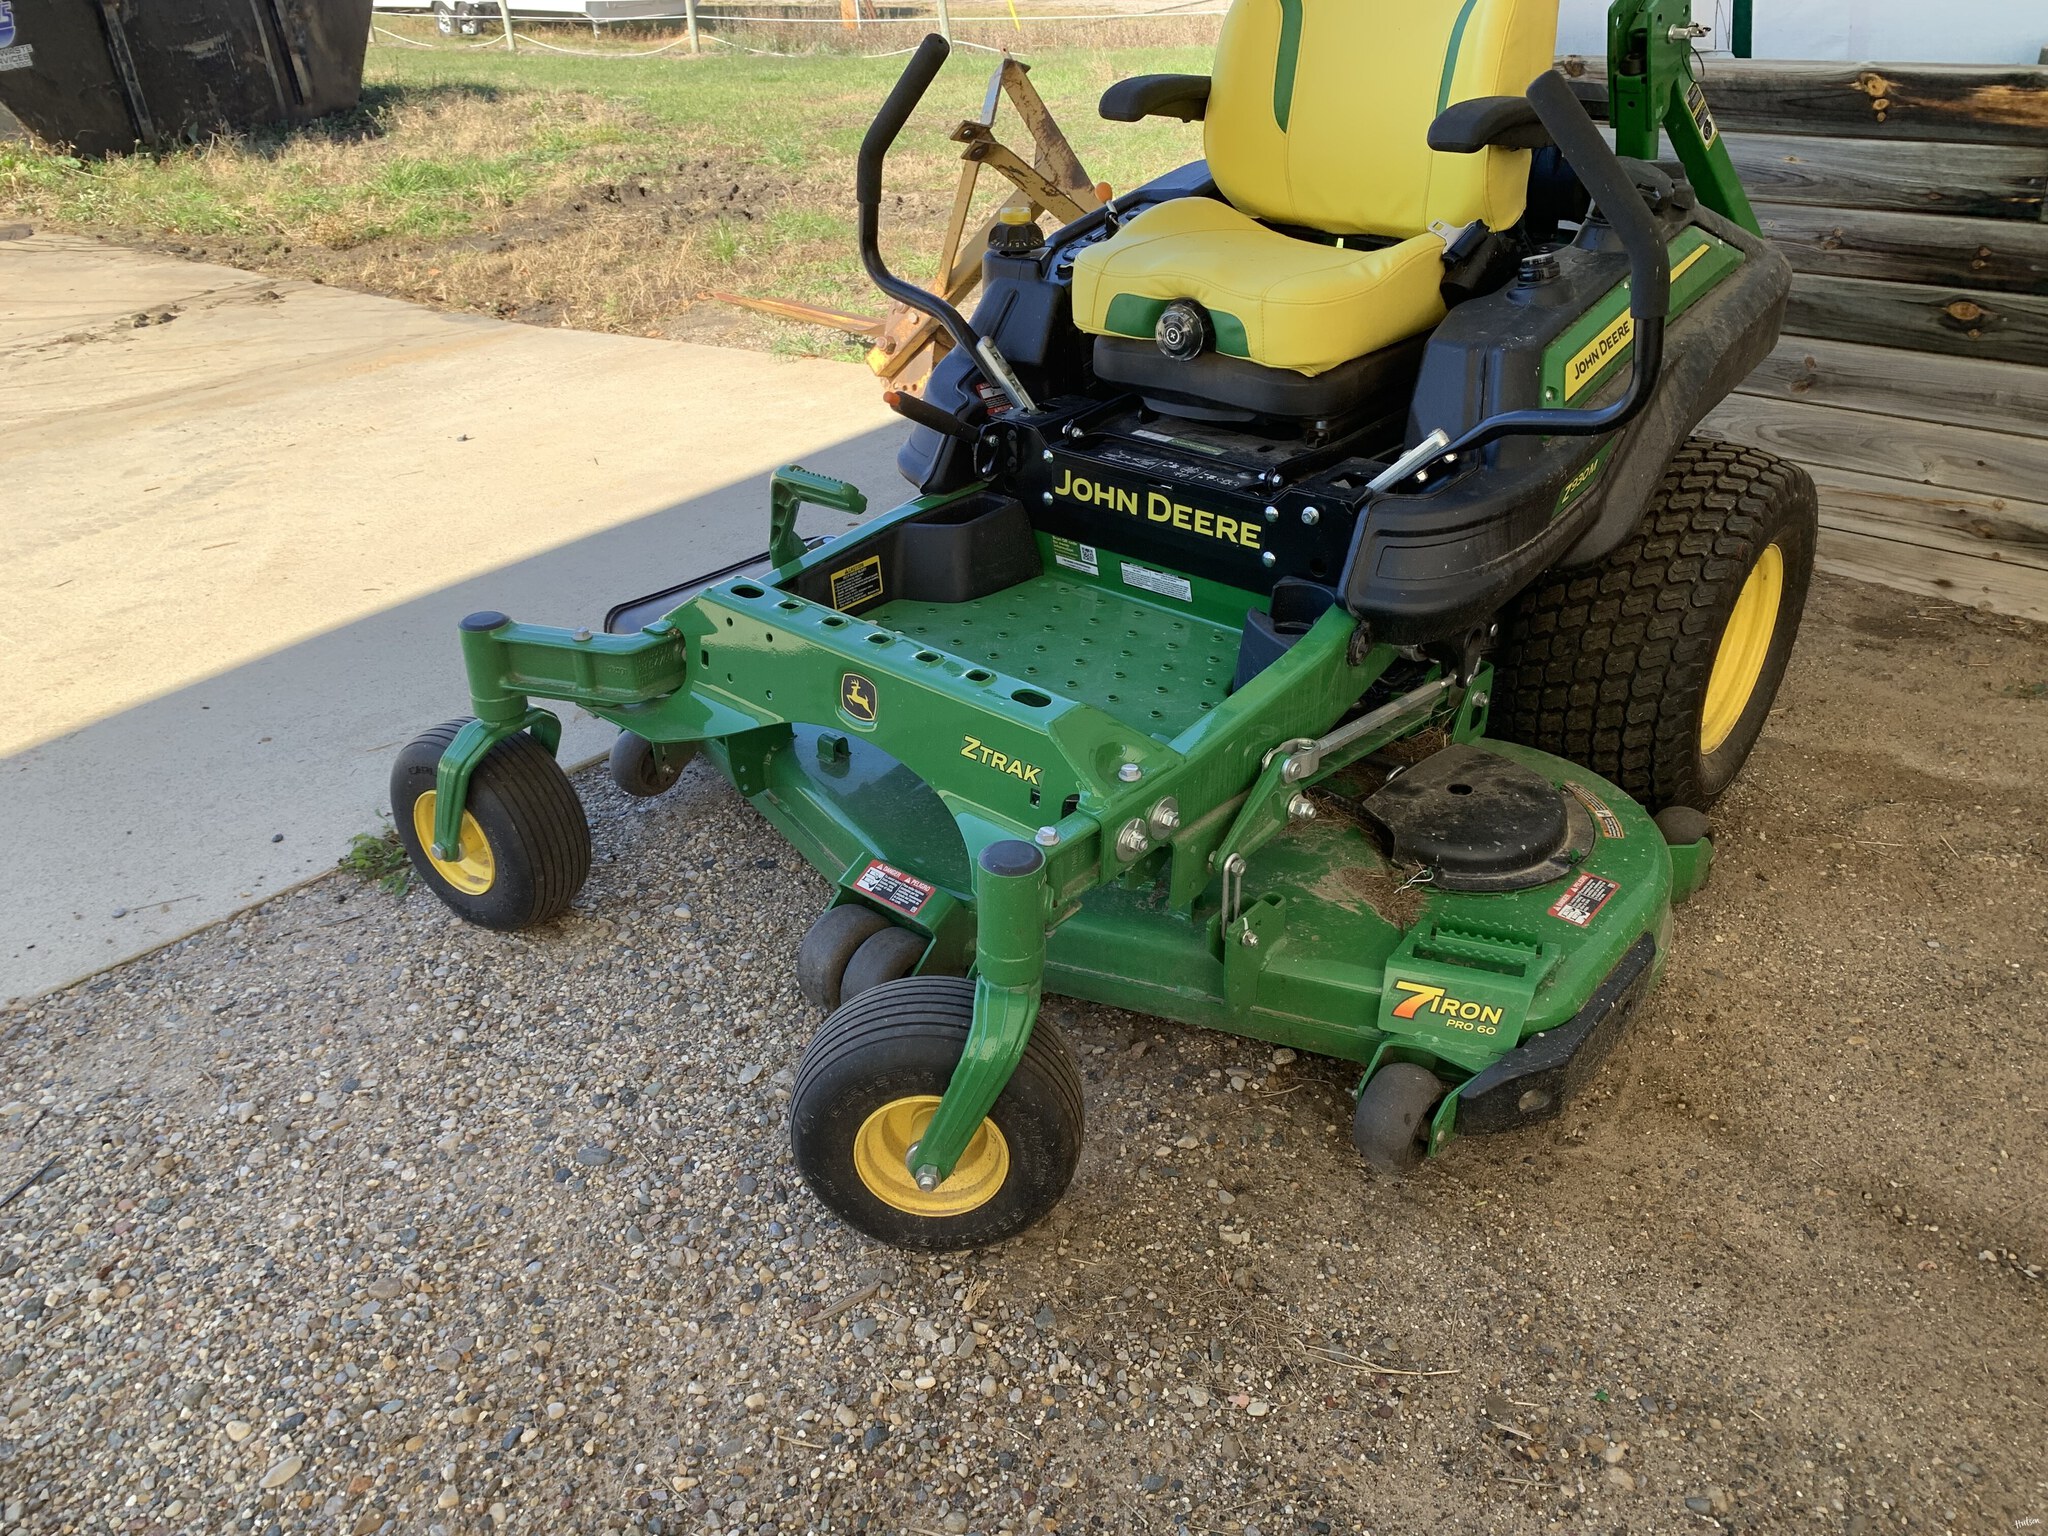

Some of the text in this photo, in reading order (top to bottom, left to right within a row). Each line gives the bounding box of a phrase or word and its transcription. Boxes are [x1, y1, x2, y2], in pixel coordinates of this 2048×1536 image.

[1574, 321, 1630, 380] JOHN DEERE
[1055, 469, 1262, 550] JOHN DEERE
[960, 734, 1042, 786] ZTRAK
[883, 865, 902, 878] DANGER
[910, 879, 931, 892] PELIGRO
[1446, 1018, 1497, 1036] PRO 60
